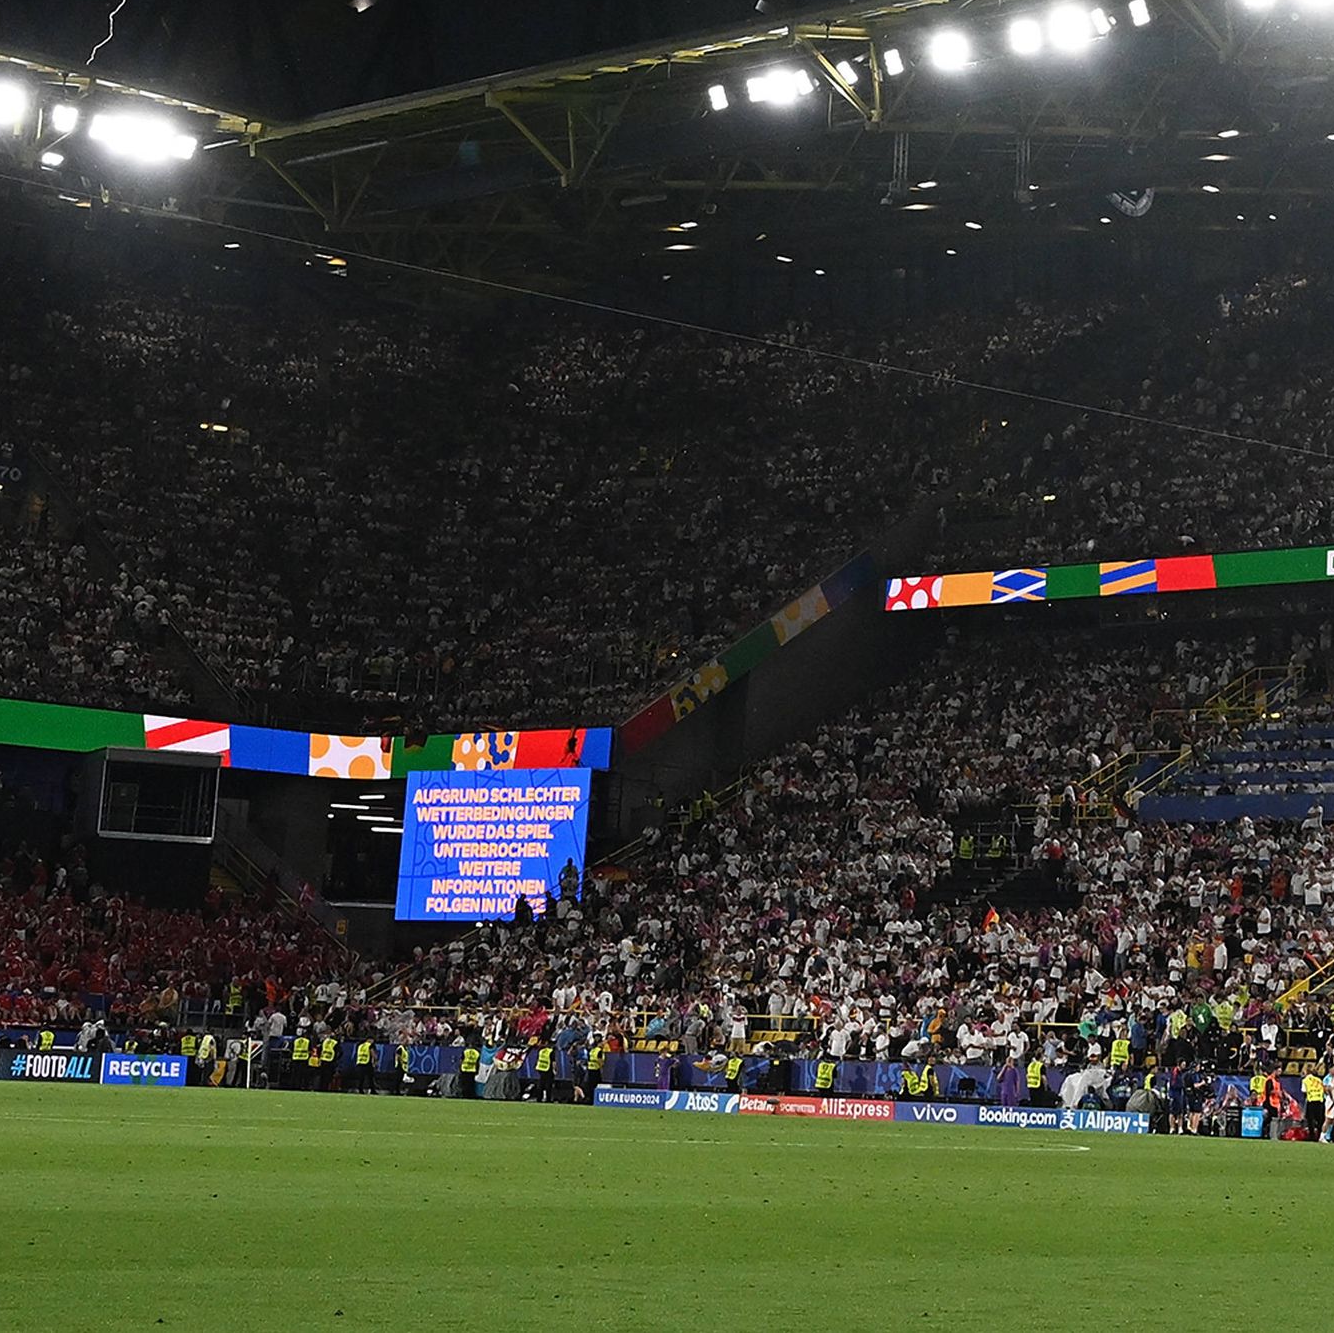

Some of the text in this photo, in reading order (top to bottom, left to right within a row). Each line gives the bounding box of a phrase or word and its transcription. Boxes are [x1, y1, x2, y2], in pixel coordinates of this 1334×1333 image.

[0, 466, 22, 482] 70
[413, 787, 580, 805] AUFGRUND SCHLECHTER
[417, 806, 574, 823] WETTERBEDINGUNGEN
[433, 824, 554, 839] WURDE DAS SPIEL
[433, 843, 549, 858] UNTERBROCHEN.
[459, 861, 521, 877] WEITERE
[432, 879, 545, 895] INFORMATIONEN
[425, 898, 481, 914] FOLGEN
[481, 898, 496, 913] IN
[11, 1056, 93, 1079] #FOOTBALL
[109, 1060, 180, 1077] RECYCLE
[819, 1099, 890, 1118] AliExpress
[912, 1104, 957, 1122] vivo
[979, 1107, 1056, 1128] Booking.com
[1085, 1111, 1131, 1133] Alipay
